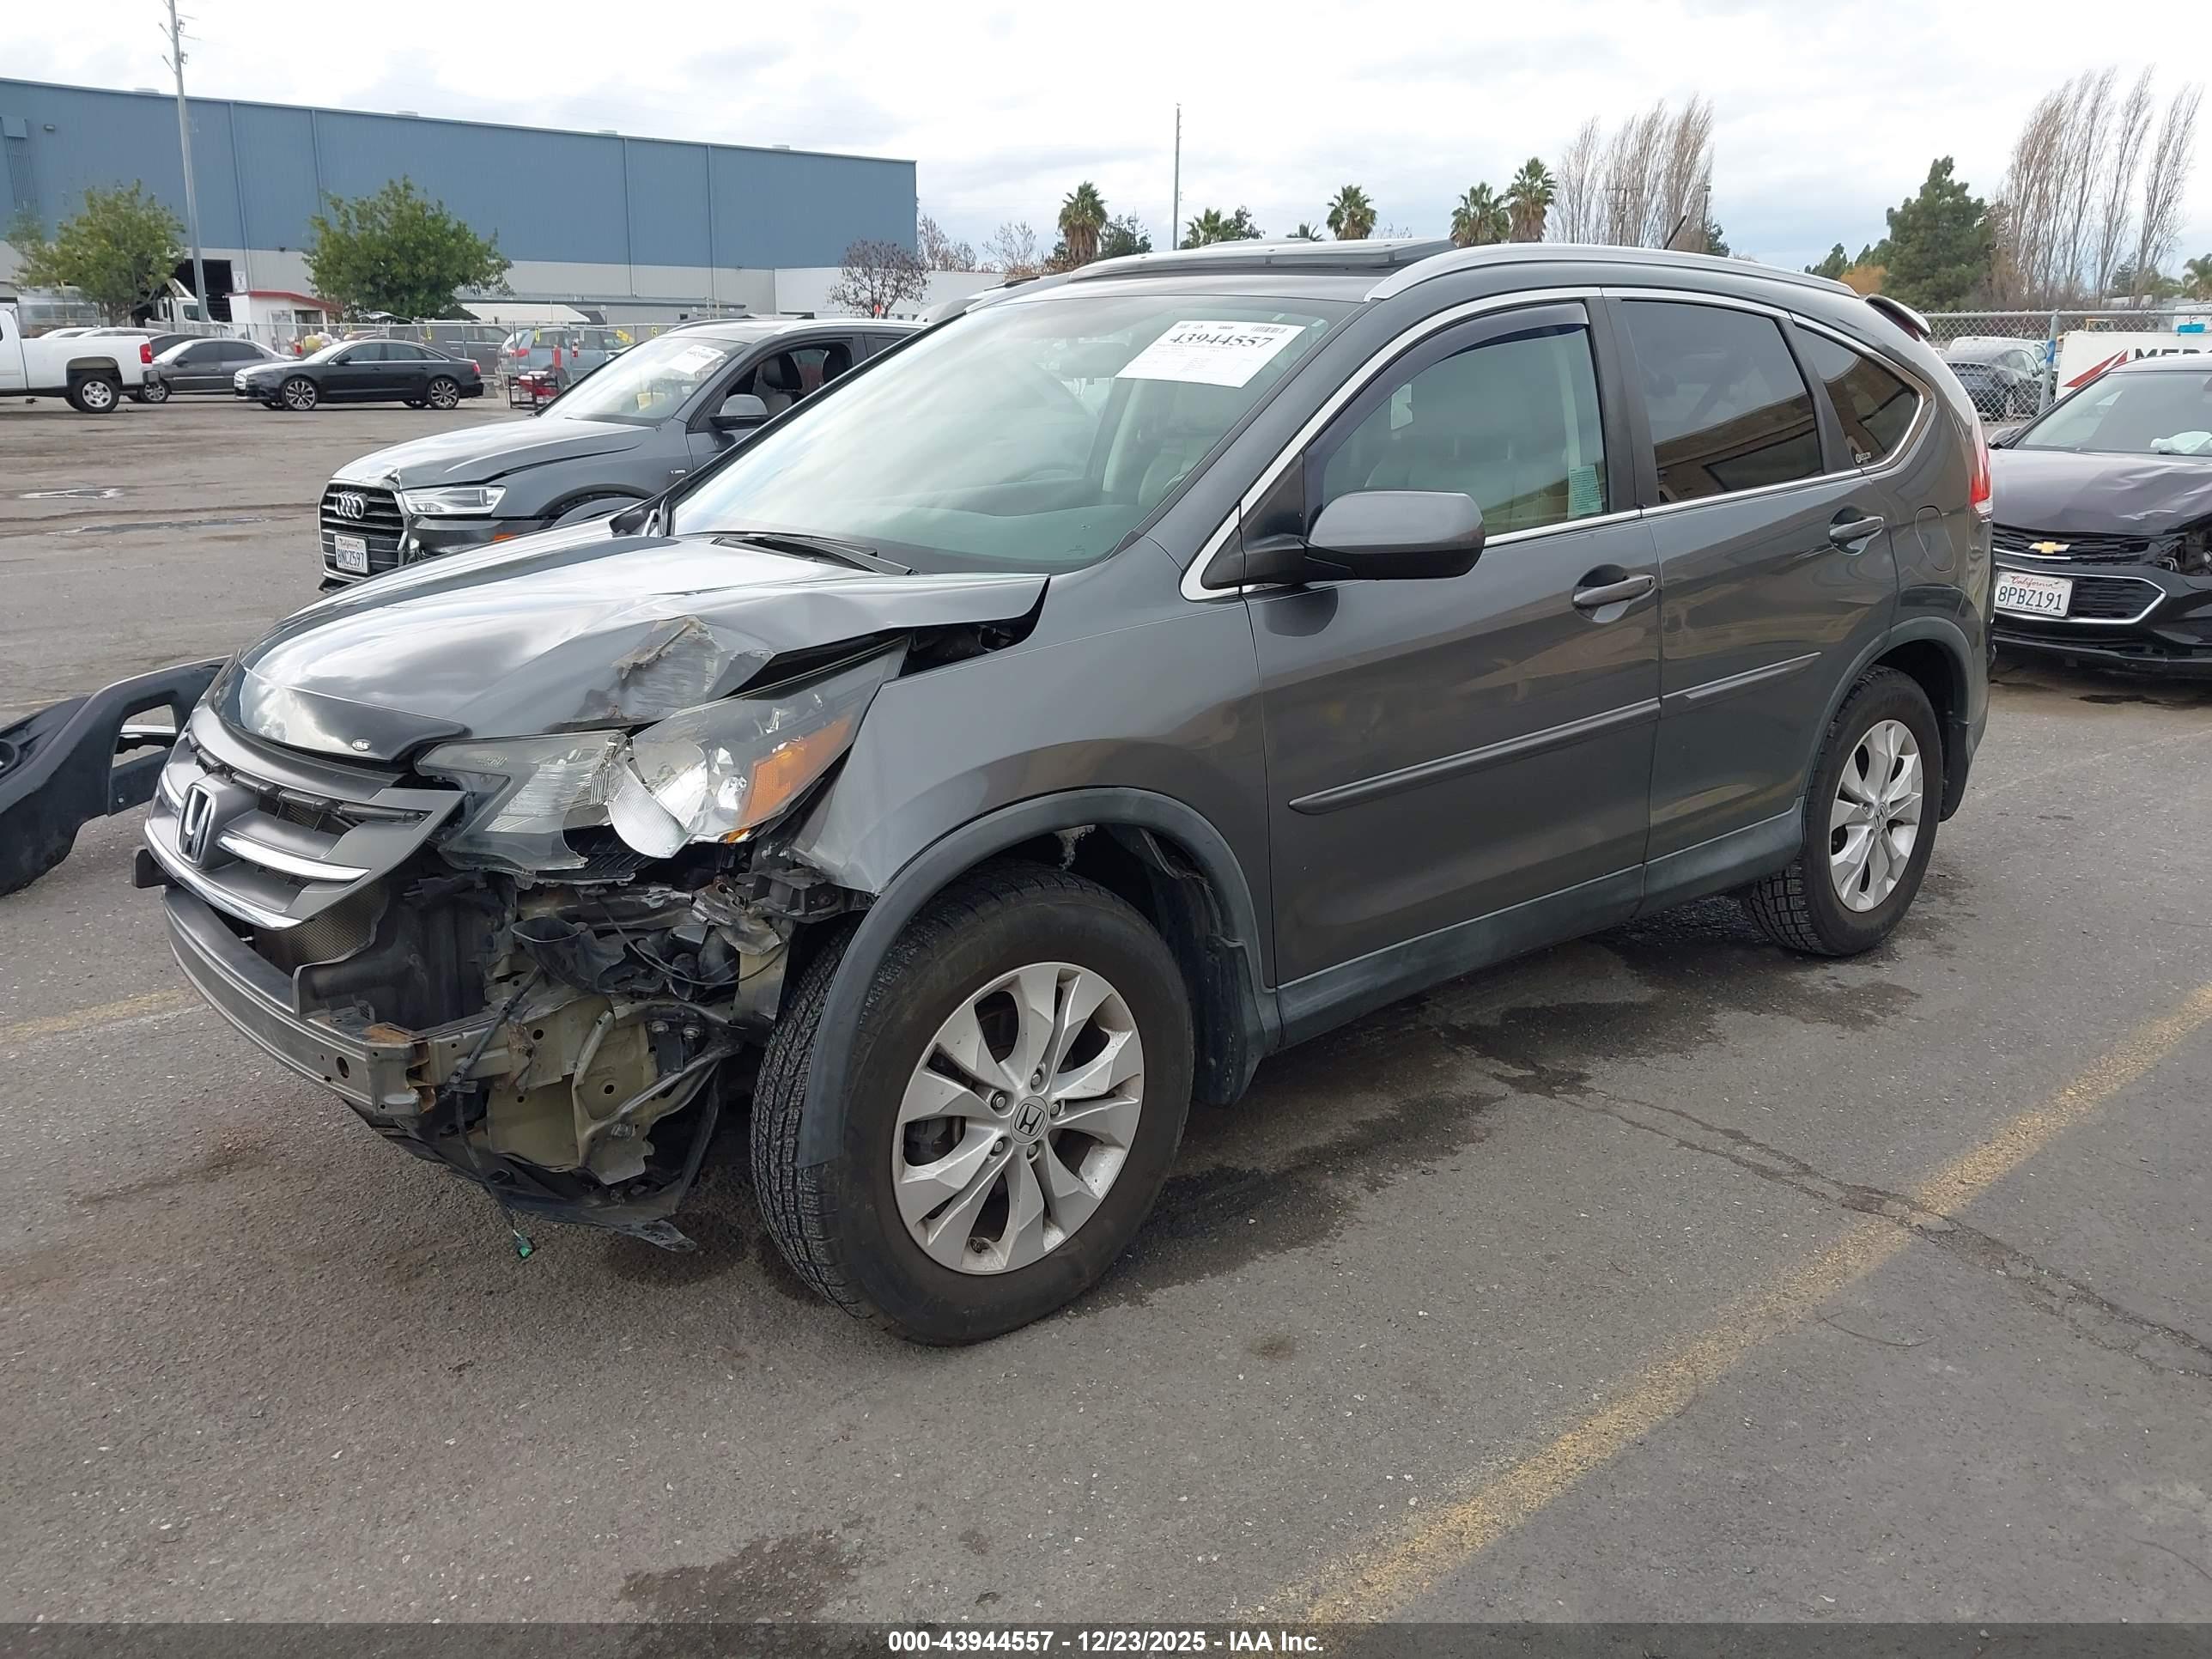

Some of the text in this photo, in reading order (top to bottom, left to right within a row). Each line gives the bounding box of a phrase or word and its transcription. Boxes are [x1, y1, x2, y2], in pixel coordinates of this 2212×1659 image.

[1170, 332, 1275, 349] 43944557
[2010, 575, 2054, 589] California
[1997, 586, 2063, 611] 8PBZ191
